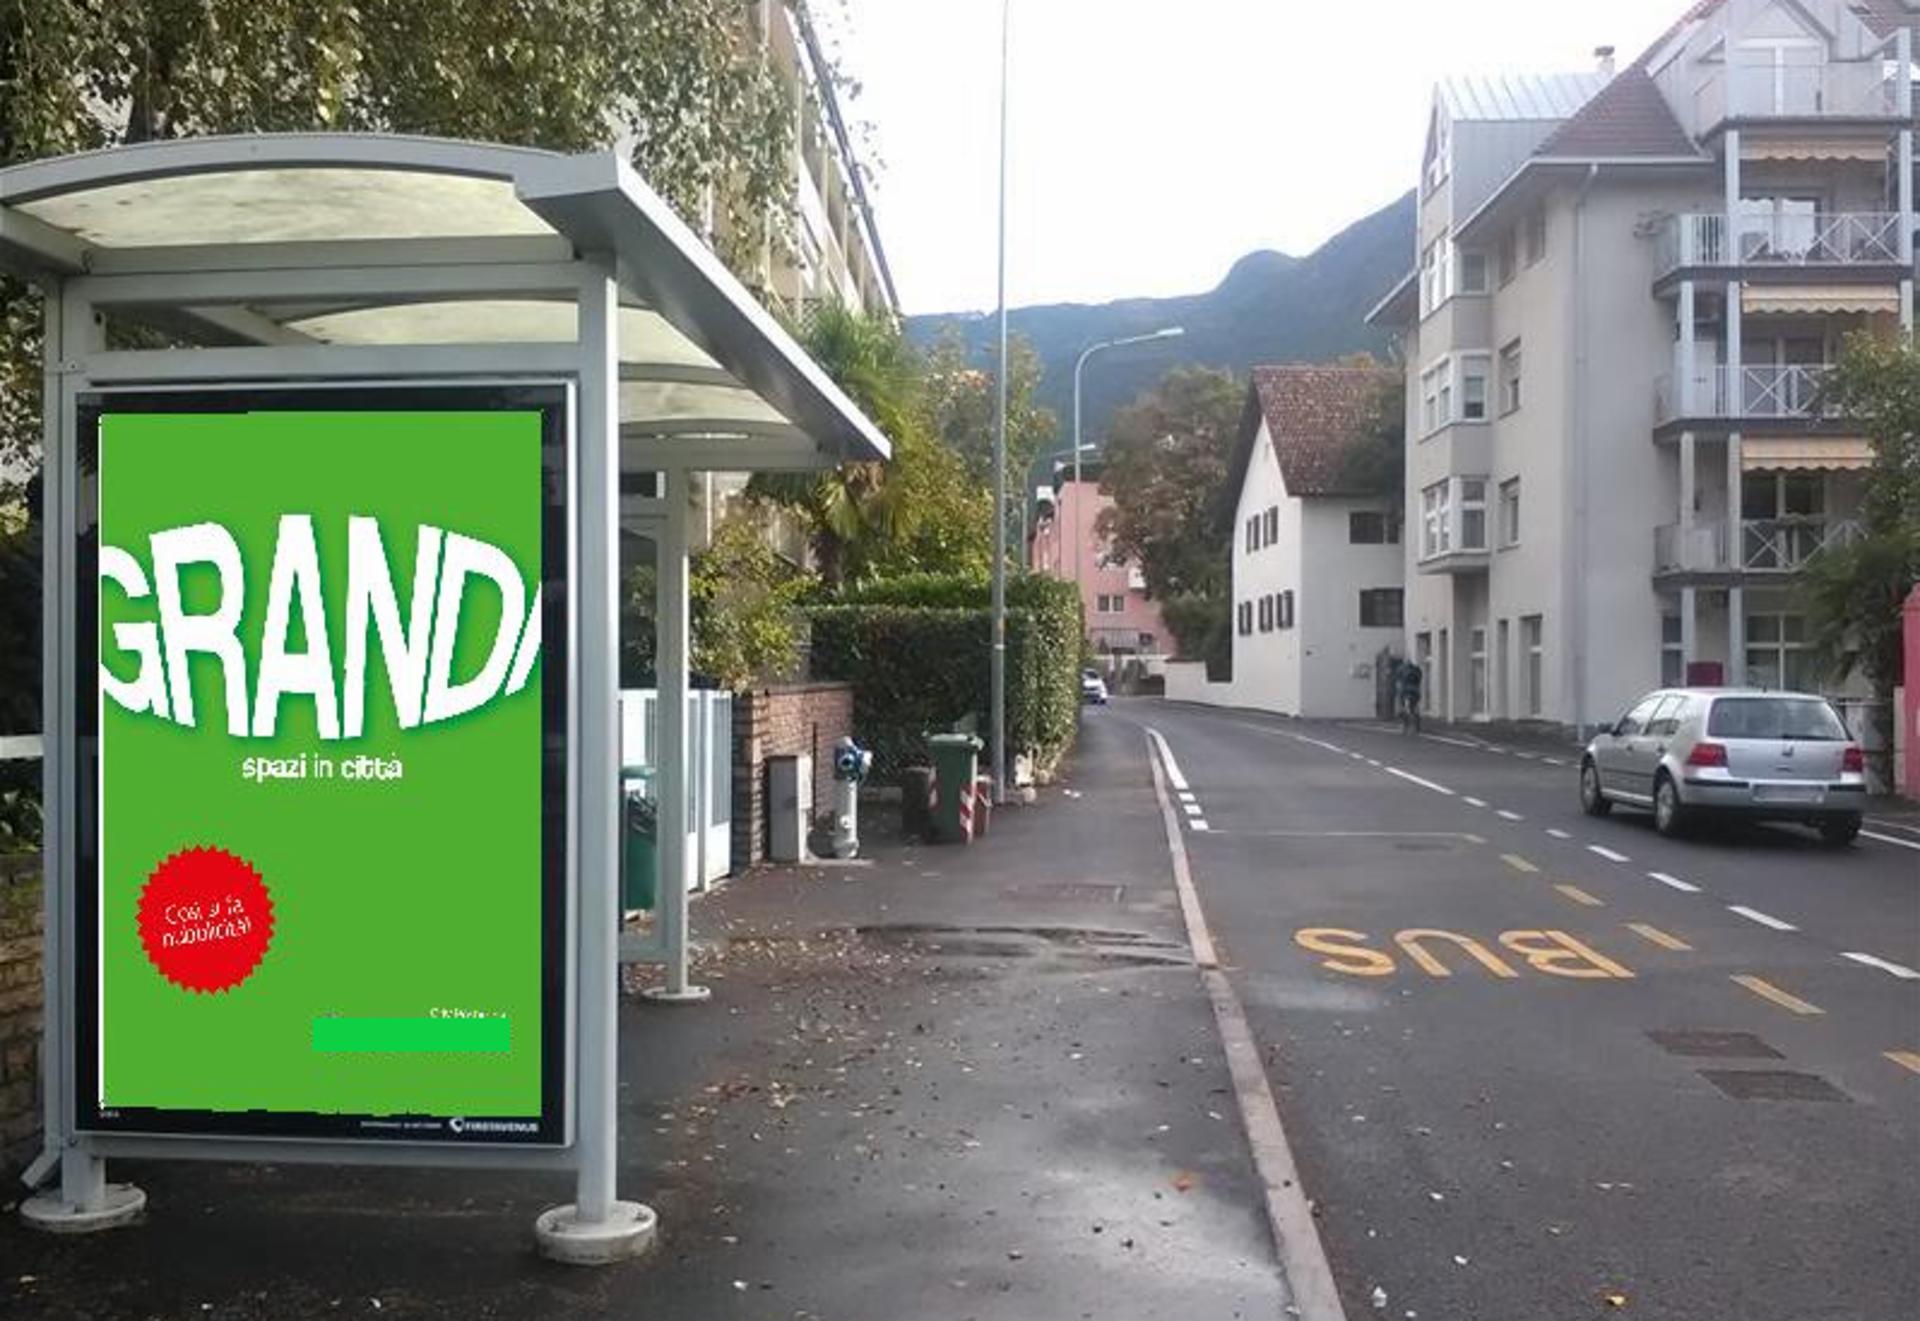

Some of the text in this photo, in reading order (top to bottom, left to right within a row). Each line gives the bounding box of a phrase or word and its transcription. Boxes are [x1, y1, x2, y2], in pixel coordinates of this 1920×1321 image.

[242, 752, 403, 783] spazi in città
[1294, 927, 1635, 978] BUS
